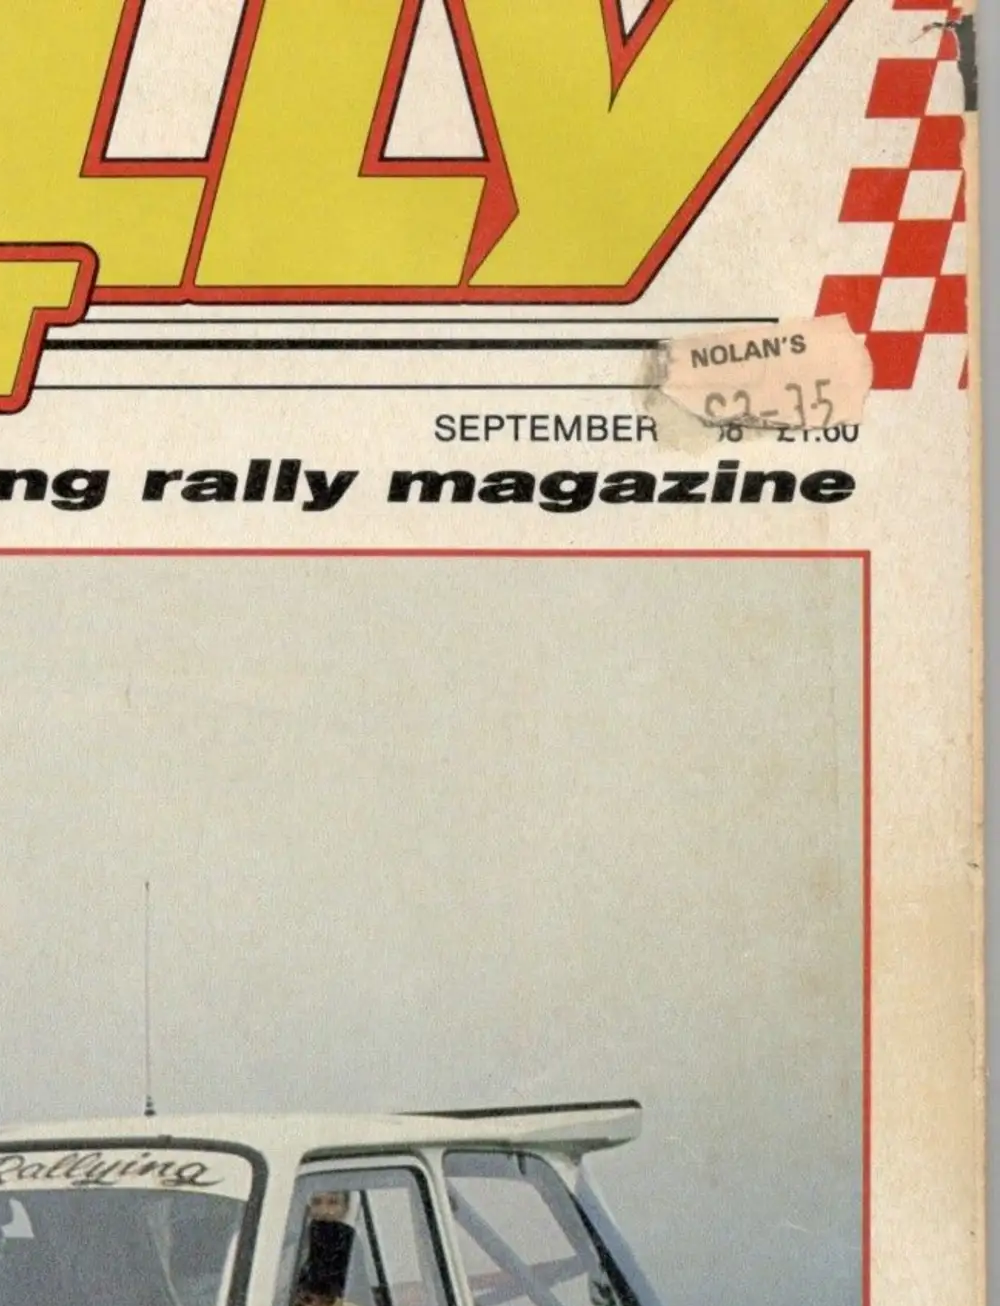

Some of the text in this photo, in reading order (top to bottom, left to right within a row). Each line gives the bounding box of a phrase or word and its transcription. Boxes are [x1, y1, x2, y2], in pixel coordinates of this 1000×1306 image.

[691, 334, 806, 368] NOLAN'S
[434, 414, 658, 443] SEPTEMBER
[142, 459, 359, 512] rally
[387, 460, 856, 513] magazine
